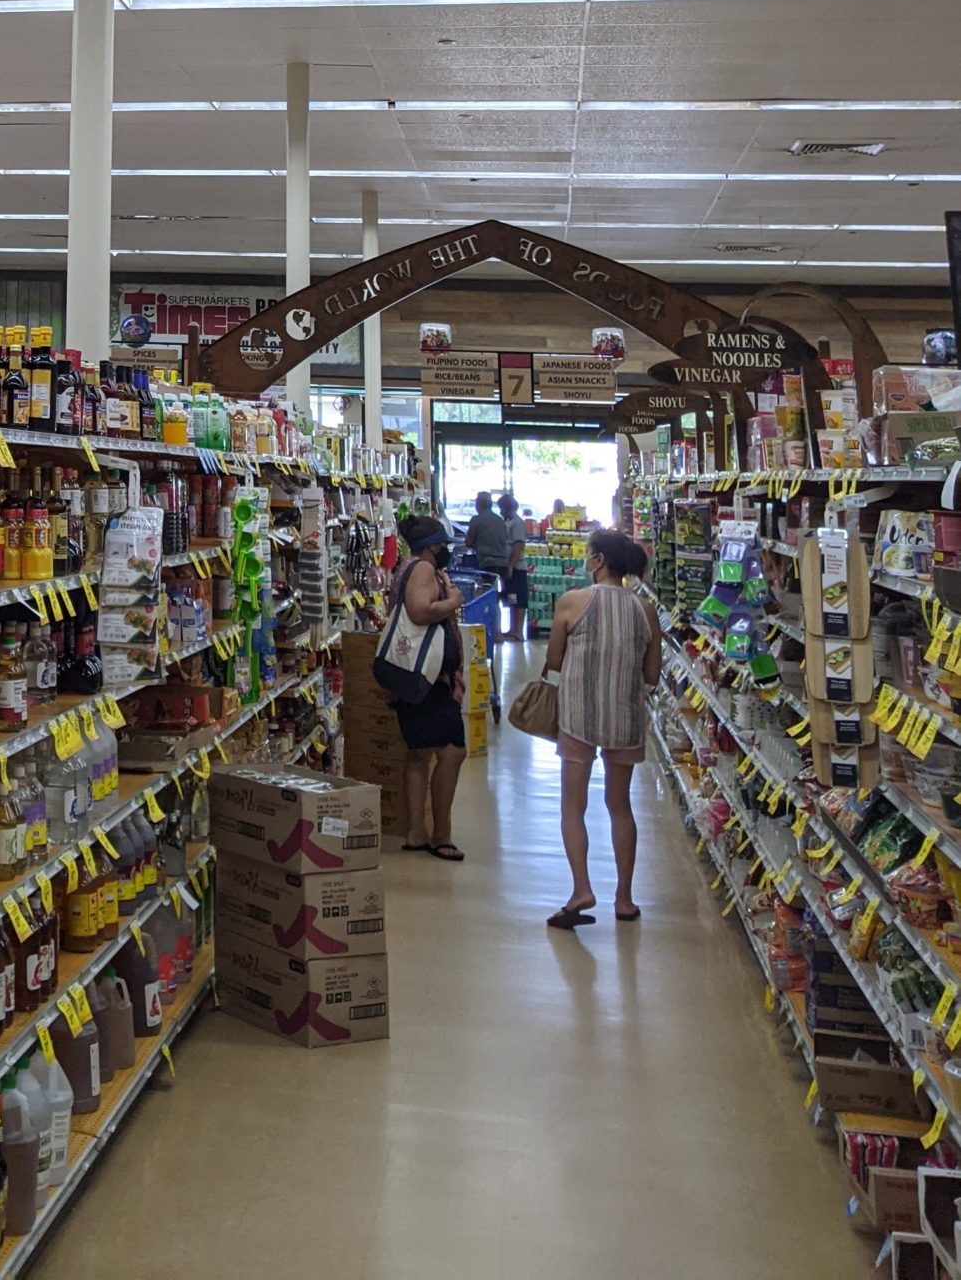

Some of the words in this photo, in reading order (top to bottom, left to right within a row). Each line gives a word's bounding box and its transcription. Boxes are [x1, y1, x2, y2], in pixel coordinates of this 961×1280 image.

[167, 294, 251, 306] SUPERMARKETS
[707, 333, 770, 348] RAMENS
[775, 335, 786, 349] &
[133, 350, 157, 359] SPICES
[712, 351, 782, 368] NOODLES
[426, 357, 458, 367] FILIPINO
[460, 358, 488, 367] FOODS
[541, 361, 581, 370] JAPANESE
[583, 362, 612, 370] FOODS
[434, 372, 481, 382] RICE/BEANS
[547, 376, 572, 384] ASIAN
[574, 377, 607, 385] SNACKS
[674, 367, 742, 384] VINEGAR
[508, 375, 525, 397] 7
[440, 387, 476, 396] VINEGAR
[563, 391, 592, 400] SHOYU
[648, 396, 687, 409] SHOYU
[631, 417, 656, 426] FOODS
